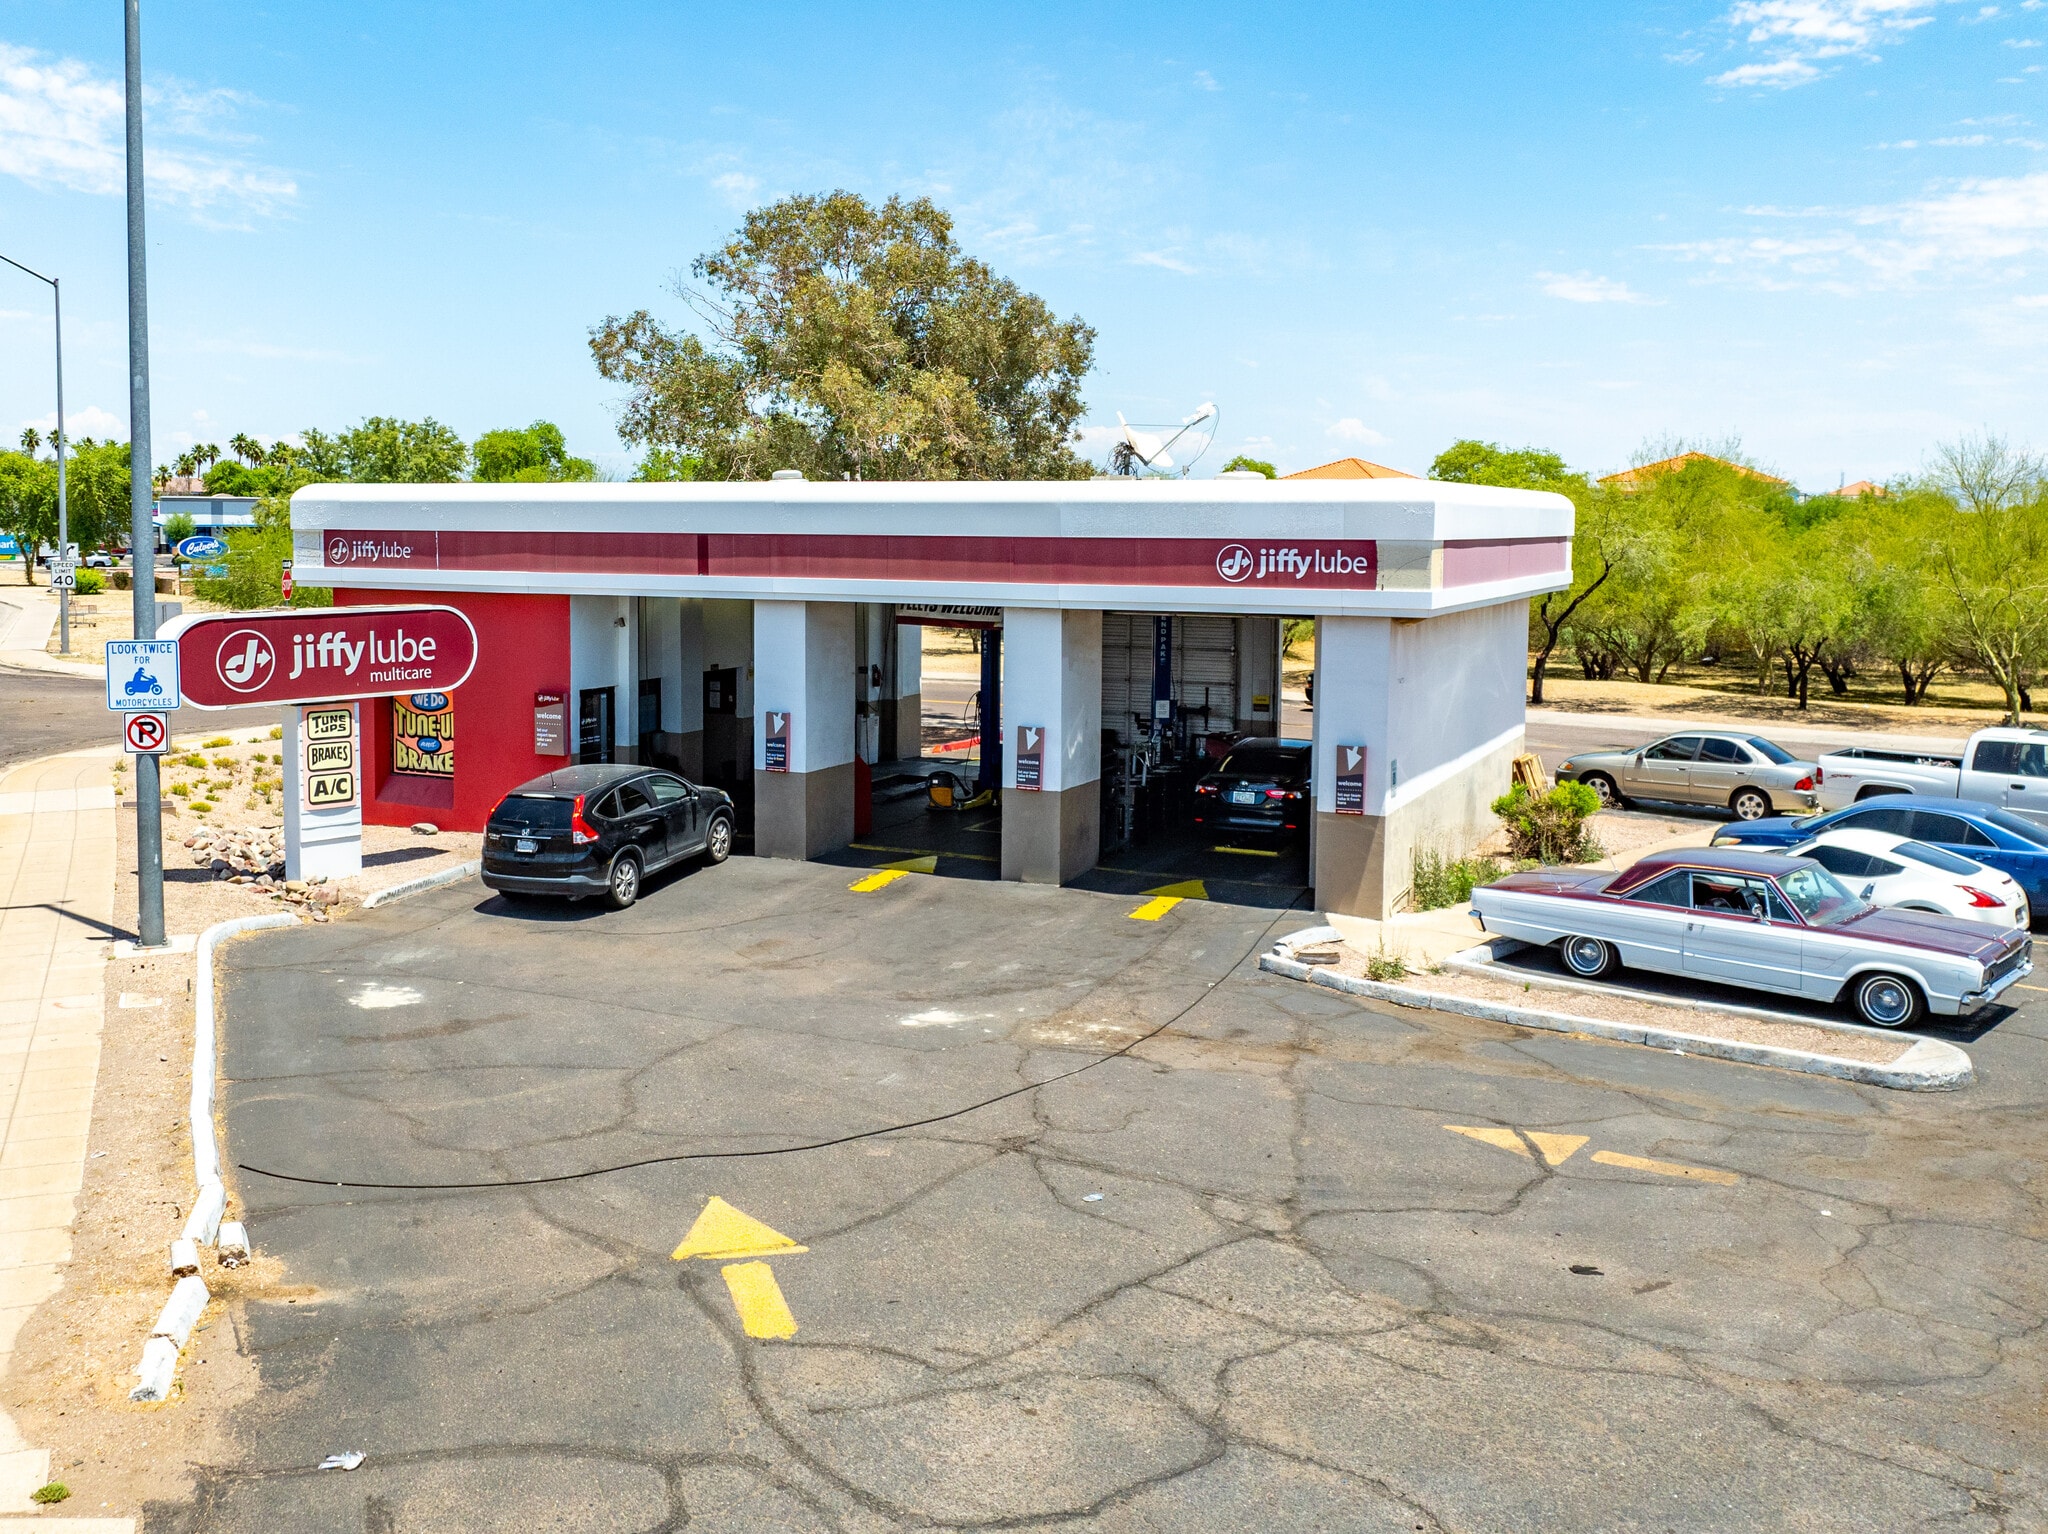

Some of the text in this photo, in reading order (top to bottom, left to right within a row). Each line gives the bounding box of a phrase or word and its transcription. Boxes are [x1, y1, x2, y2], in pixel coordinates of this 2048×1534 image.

[186, 540, 220, 555] Culver's
[53, 575, 74, 586] 40
[111, 643, 173, 655] LOOK TWICE
[134, 655, 151, 665] FOR
[369, 667, 432, 683] multicare
[116, 697, 172, 707] MOTORCYCLES
[414, 694, 444, 707] WE DO
[311, 714, 347, 730] TUNE
[395, 701, 454, 739] TUNE-U
[536, 712, 562, 720] welcome
[420, 740, 437, 748] and
[312, 745, 348, 766] BRAKES
[314, 778, 347, 797] A/C
